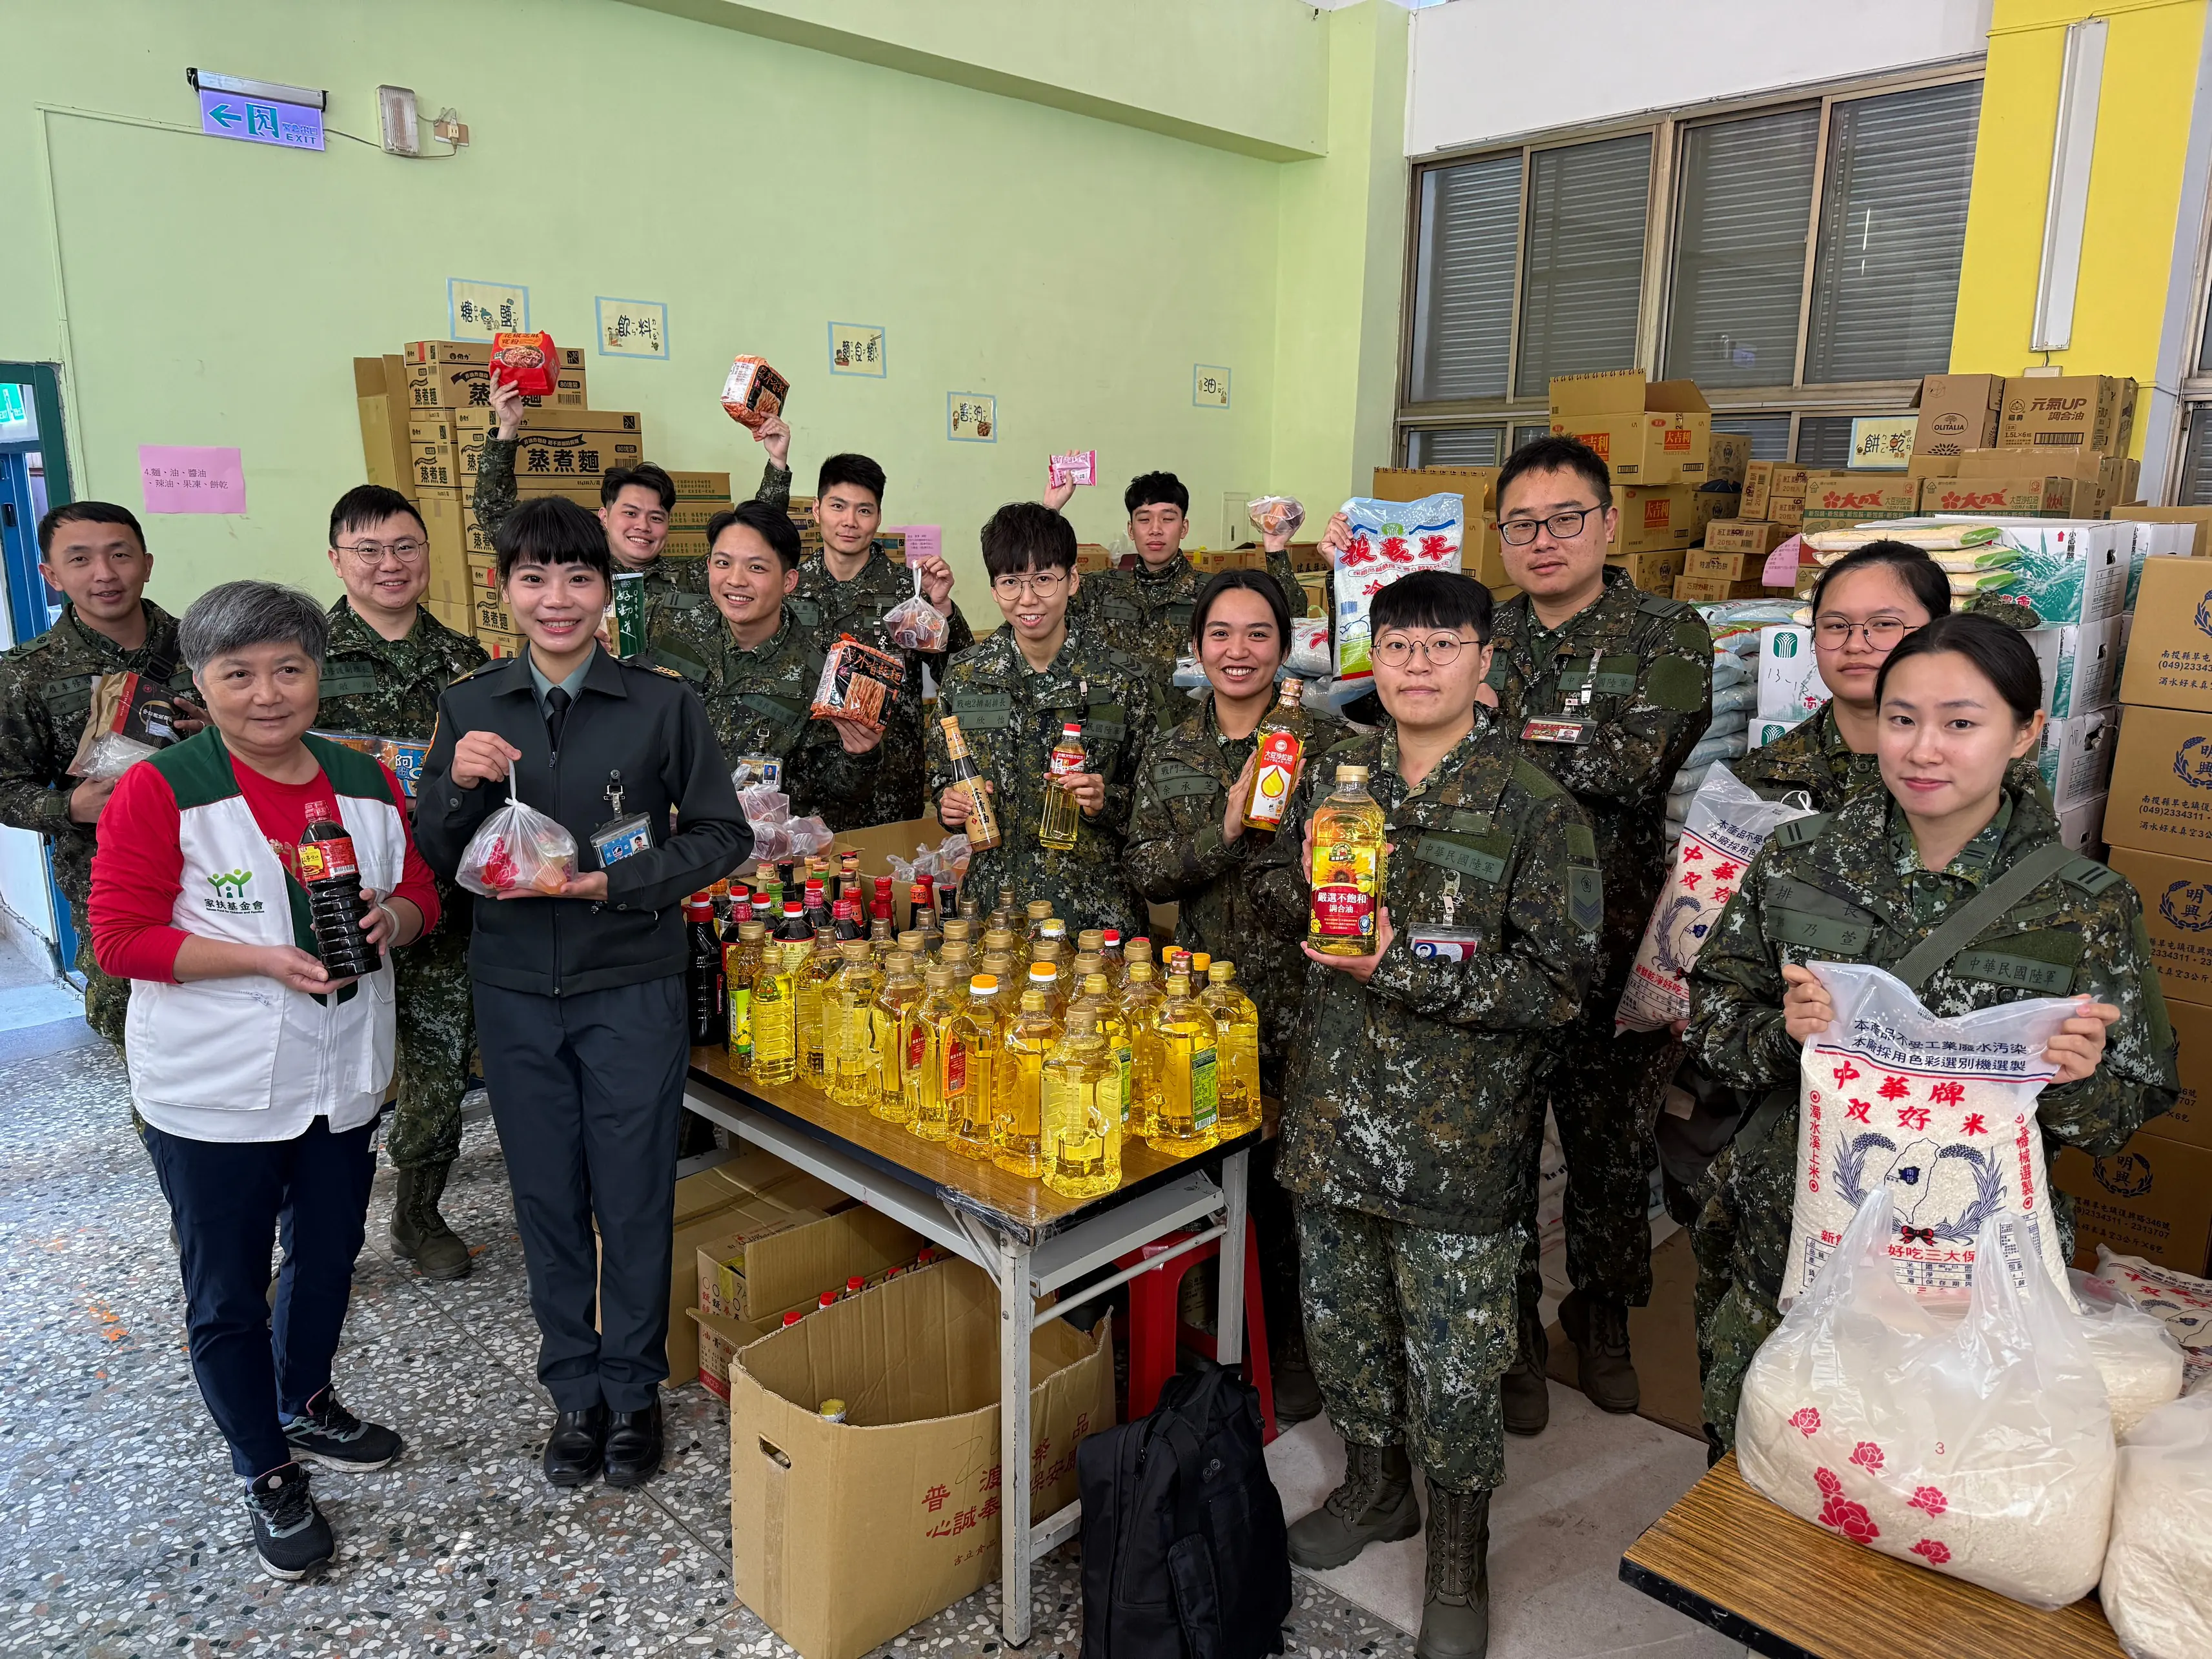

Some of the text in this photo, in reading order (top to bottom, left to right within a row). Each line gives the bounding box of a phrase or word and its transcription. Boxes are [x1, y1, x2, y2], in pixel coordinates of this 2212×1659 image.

[287, 133, 317, 145] EXIT
[460, 300, 473, 323] 糖
[618, 314, 652, 338] 飲料
[1203, 378, 1216, 393] 油
[414, 387, 438, 405] 蒸煮麵
[2029, 398, 2087, 411] 元氣UP
[2048, 411, 2085, 421] 調合油
[1665, 431, 1690, 443] 大吉利
[1865, 433, 1905, 453] 餅乾
[527, 448, 600, 473] 蒸煮麵
[421, 466, 448, 484] 蒸煮麵
[1838, 490, 1883, 509] 大成
[1958, 489, 2008, 509] 大成
[2009, 495, 2039, 504] 大豆沙拉油
[1645, 501, 1670, 518] 大吉利
[2065, 530, 2077, 560] 小心輕放
[482, 609, 509, 631] 蒸煮麵
[395, 755, 412, 768] 阿
[1264, 749, 1293, 762] 大豆沙拉油
[2138, 805, 2203, 820] (049)2334311
[2142, 795, 2212, 812] 南投縣草屯鎮復
[1425, 842, 1495, 875] 中華民國陸軍
[204, 899, 263, 911] 家扶基金會
[1317, 892, 1367, 904] 嚴選不飽和
[2180, 888, 2204, 920] 明興
[1329, 904, 1354, 913] 調合油
[1969, 957, 2056, 985] 中華民國陸軍
[1851, 1037, 2027, 1072] 本廠採用色彩選別機選製
[1832, 1061, 1965, 1107] 中華牌
[1844, 1097, 1989, 1136] 双好米
[1809, 1103, 1821, 1177] 濁水溪上米
[2131, 1222, 2170, 1239] 2313707
[1887, 1244, 1975, 1263] 好吃三大保
[704, 1373, 720, 1391] HACCP
[1935, 1441, 1945, 1455] 3
